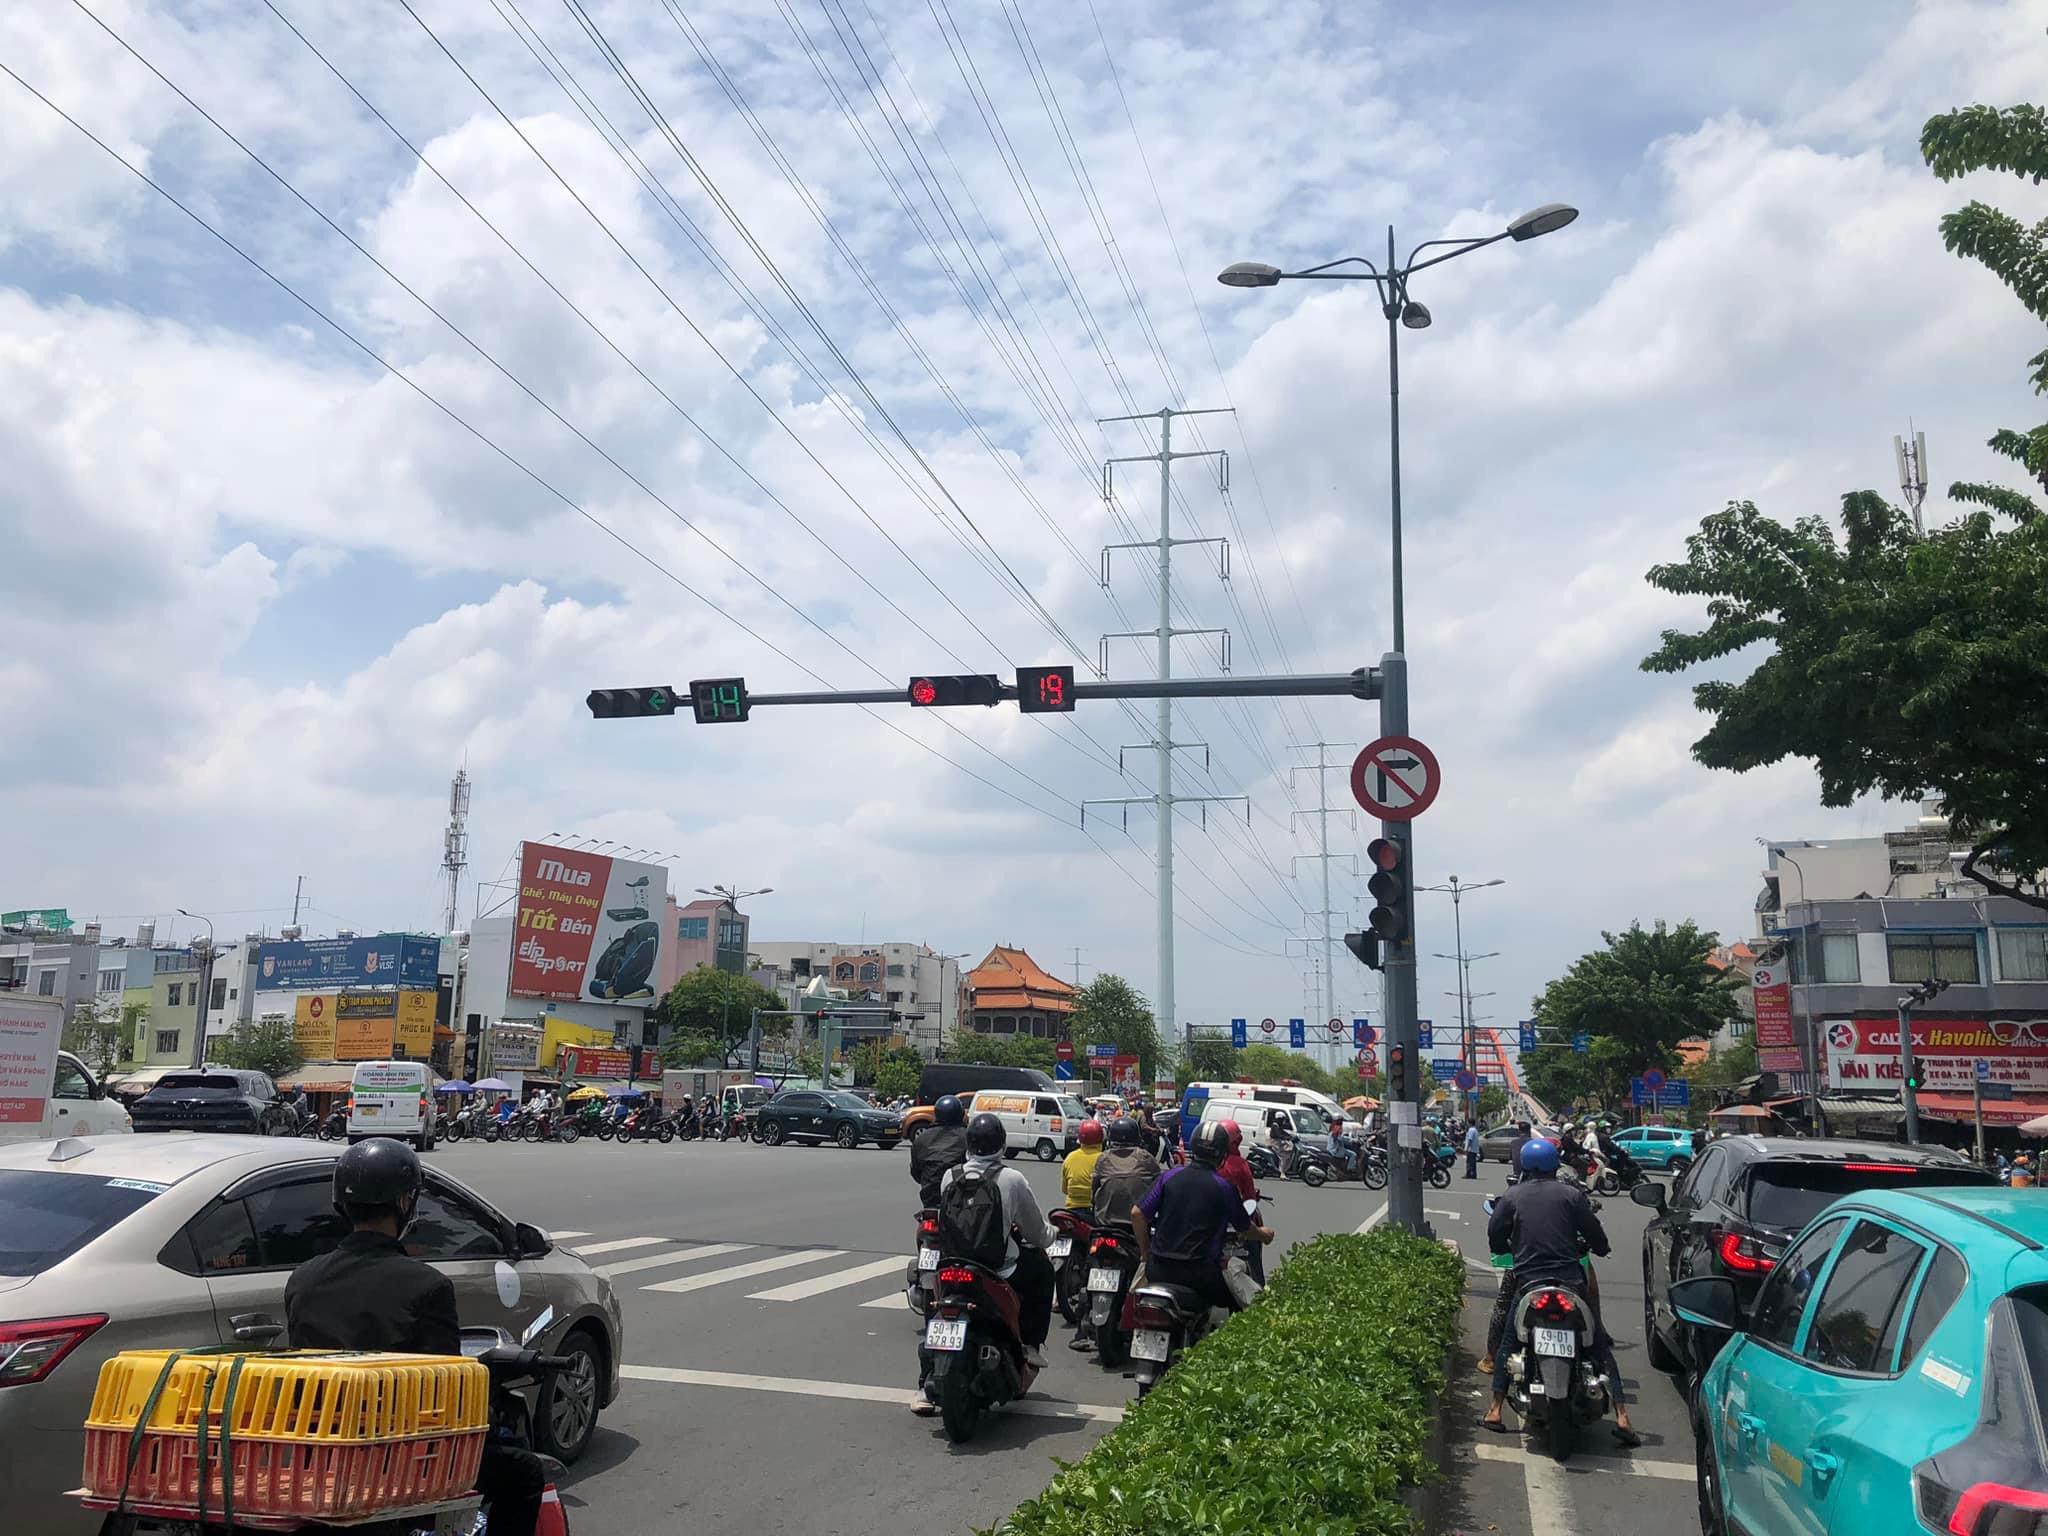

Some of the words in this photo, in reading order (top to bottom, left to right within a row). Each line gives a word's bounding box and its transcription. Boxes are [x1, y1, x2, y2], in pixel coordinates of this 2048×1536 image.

[712, 687, 741, 717] 14
[1040, 674, 1063, 705] 19
[536, 858, 592, 887] Mua
[549, 890, 572, 904] Máy
[575, 895, 599, 909] Chạy
[520, 907, 557, 931] Tốt
[560, 917, 592, 936] Đến
[1929, 1071, 1940, 1079] XE
